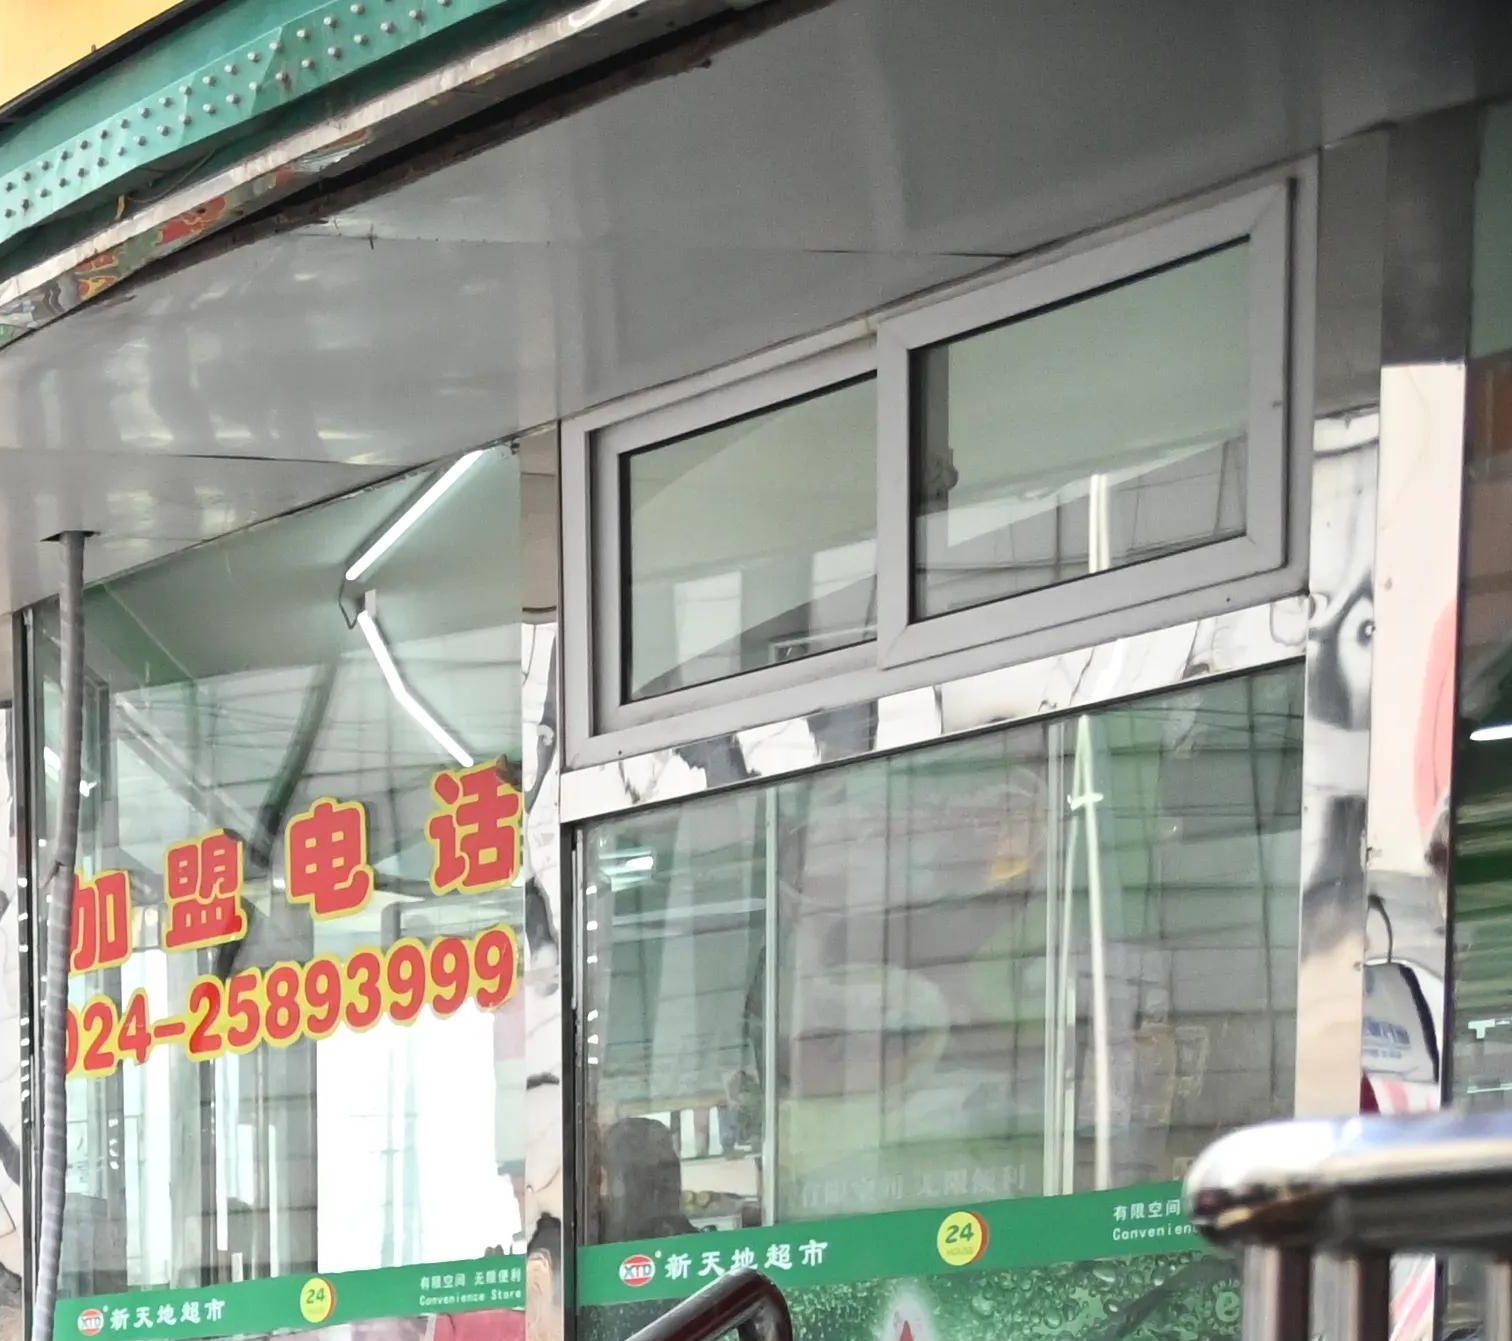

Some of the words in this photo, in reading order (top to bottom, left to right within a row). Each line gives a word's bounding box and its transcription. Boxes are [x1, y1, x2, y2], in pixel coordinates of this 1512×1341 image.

[1113, 1199, 1181, 1221] 有限空间
[944, 1222, 975, 1243] 24
[666, 1239, 828, 1280] 新天地超市
[305, 1287, 325, 1304] 24
[110, 1298, 226, 1331] 新天地超市
